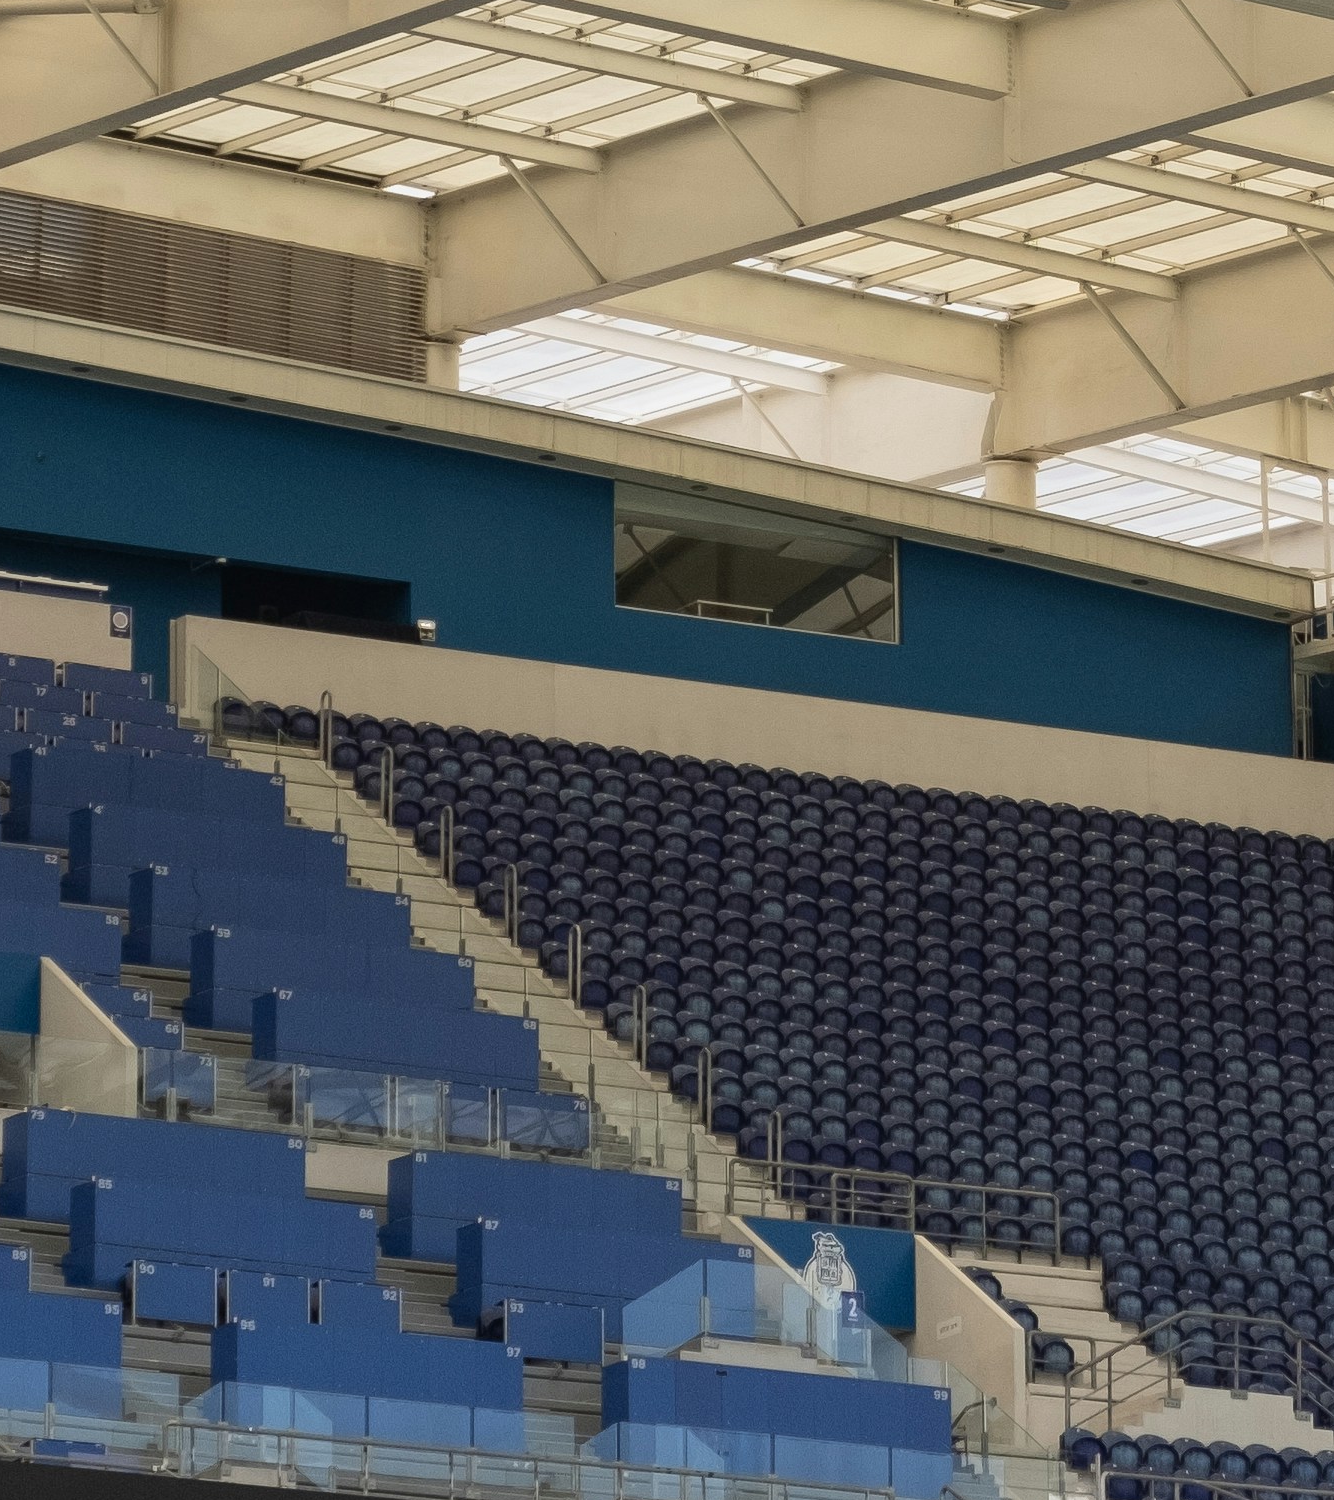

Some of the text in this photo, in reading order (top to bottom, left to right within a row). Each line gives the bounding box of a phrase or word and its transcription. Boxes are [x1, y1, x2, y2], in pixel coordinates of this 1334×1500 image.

[37, 687, 46, 696] 17
[193, 735, 205, 743] 27
[35, 747, 46, 755] 41
[45, 854, 57, 864] 52
[106, 915, 119, 925] 58
[458, 958, 472, 967] 60
[133, 992, 147, 1001] 64
[165, 1024, 179, 1034] 66
[523, 1020, 536, 1029] 68
[574, 1101, 586, 1110] 76
[31, 1110, 45, 1120] 79
[288, 1139, 303, 1149] 80
[666, 1181, 680, 1191] 82
[485, 1220, 499, 1230] 87
[12, 1250, 27, 1260] 89
[139, 1264, 155, 1274] 90
[263, 1277, 275, 1287] 91
[383, 1290, 397, 1301] 92
[510, 1303, 523, 1314] 93
[848, 1298, 858, 1317] 2
[507, 1347, 520, 1357] 97
[934, 1390, 948, 1400] 99
